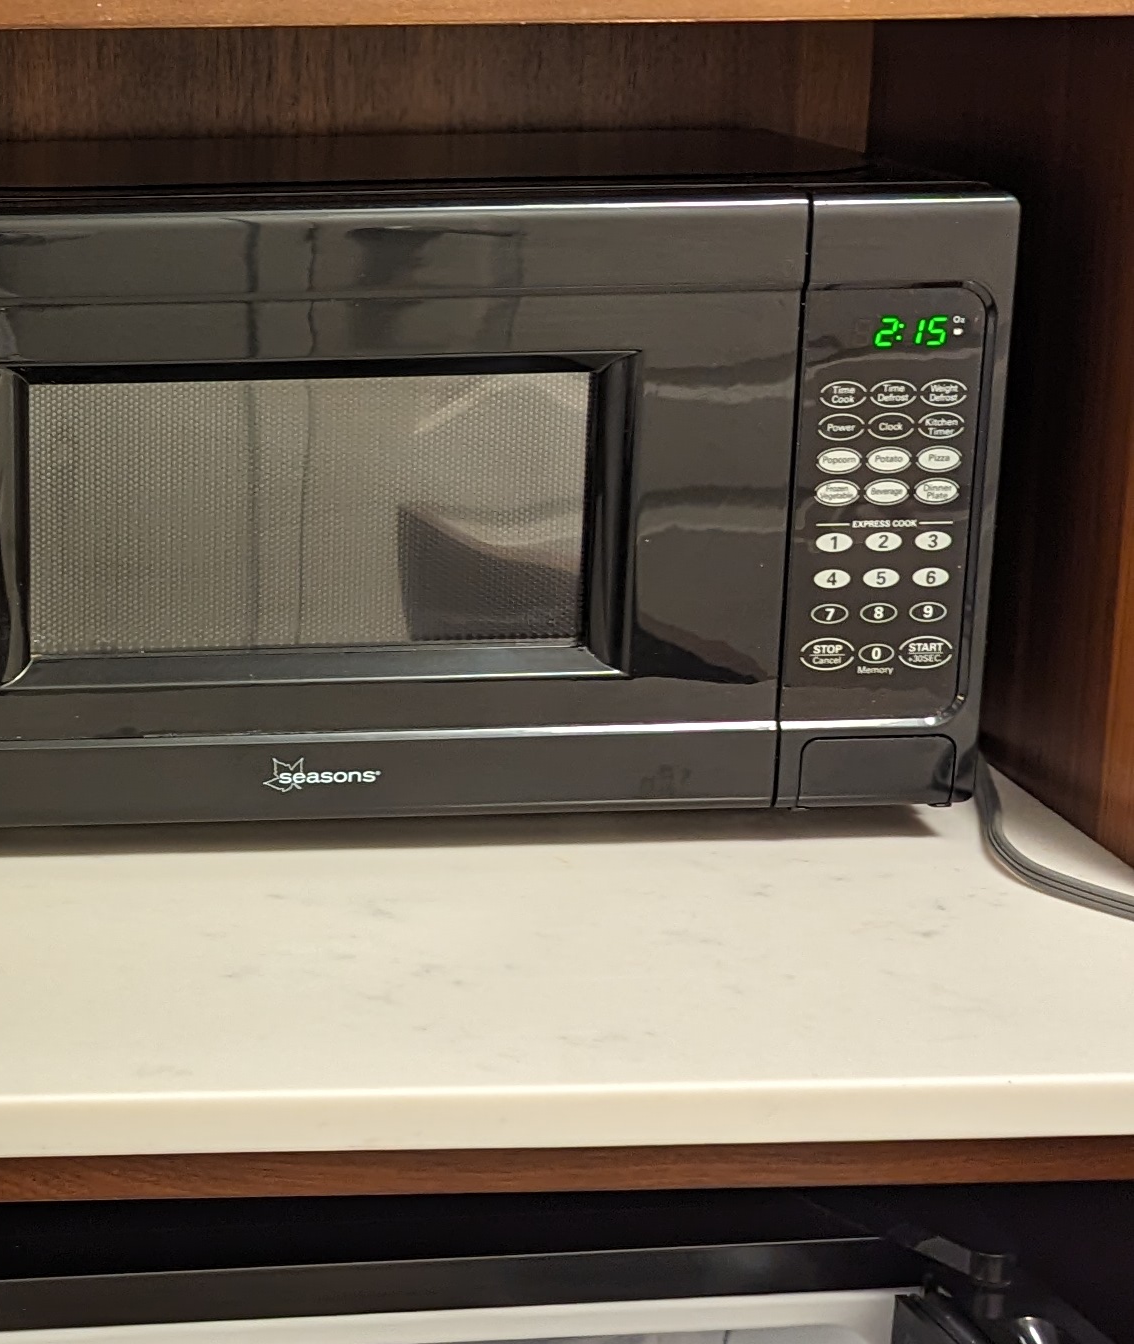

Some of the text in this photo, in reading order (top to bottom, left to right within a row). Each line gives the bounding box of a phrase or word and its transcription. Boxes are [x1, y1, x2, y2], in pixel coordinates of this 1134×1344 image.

[875, 317, 948, 347] 2:15
[832, 385, 856, 394] Time
[883, 384, 905, 392] Time
[930, 384, 958, 394] Weight
[831, 395, 855, 404] Cook
[877, 393, 909, 402] Defrost
[929, 393, 958, 402] Defrost
[878, 422, 903, 431] Clock
[925, 418, 958, 427] Kitchen
[827, 423, 856, 432] Power
[927, 427, 955, 436] Timer
[822, 456, 856, 465] Popcorn
[874, 454, 904, 463] Potato
[928, 454, 950, 462] Pizza
[871, 487, 904, 497] Beverage
[923, 484, 952, 492] Dinner
[852, 519, 918, 528] EXPRESS COOK
[830, 536, 838, 550] 1
[878, 535, 889, 549] 2
[927, 534, 938, 548] 3
[826, 572, 837, 586] 4
[876, 571, 886, 585] 5
[926, 570, 936, 584] 6
[824, 608, 835, 621] 7
[873, 606, 884, 619] 8
[923, 605, 934, 618] 9
[813, 644, 843, 654] STOP
[908, 642, 944, 653] START
[871, 647, 882, 660] 0
[812, 656, 842, 664] Cancel
[908, 654, 942, 663] +30SEC
[857, 666, 894, 675] Memory
[278, 770, 377, 784] seasons
